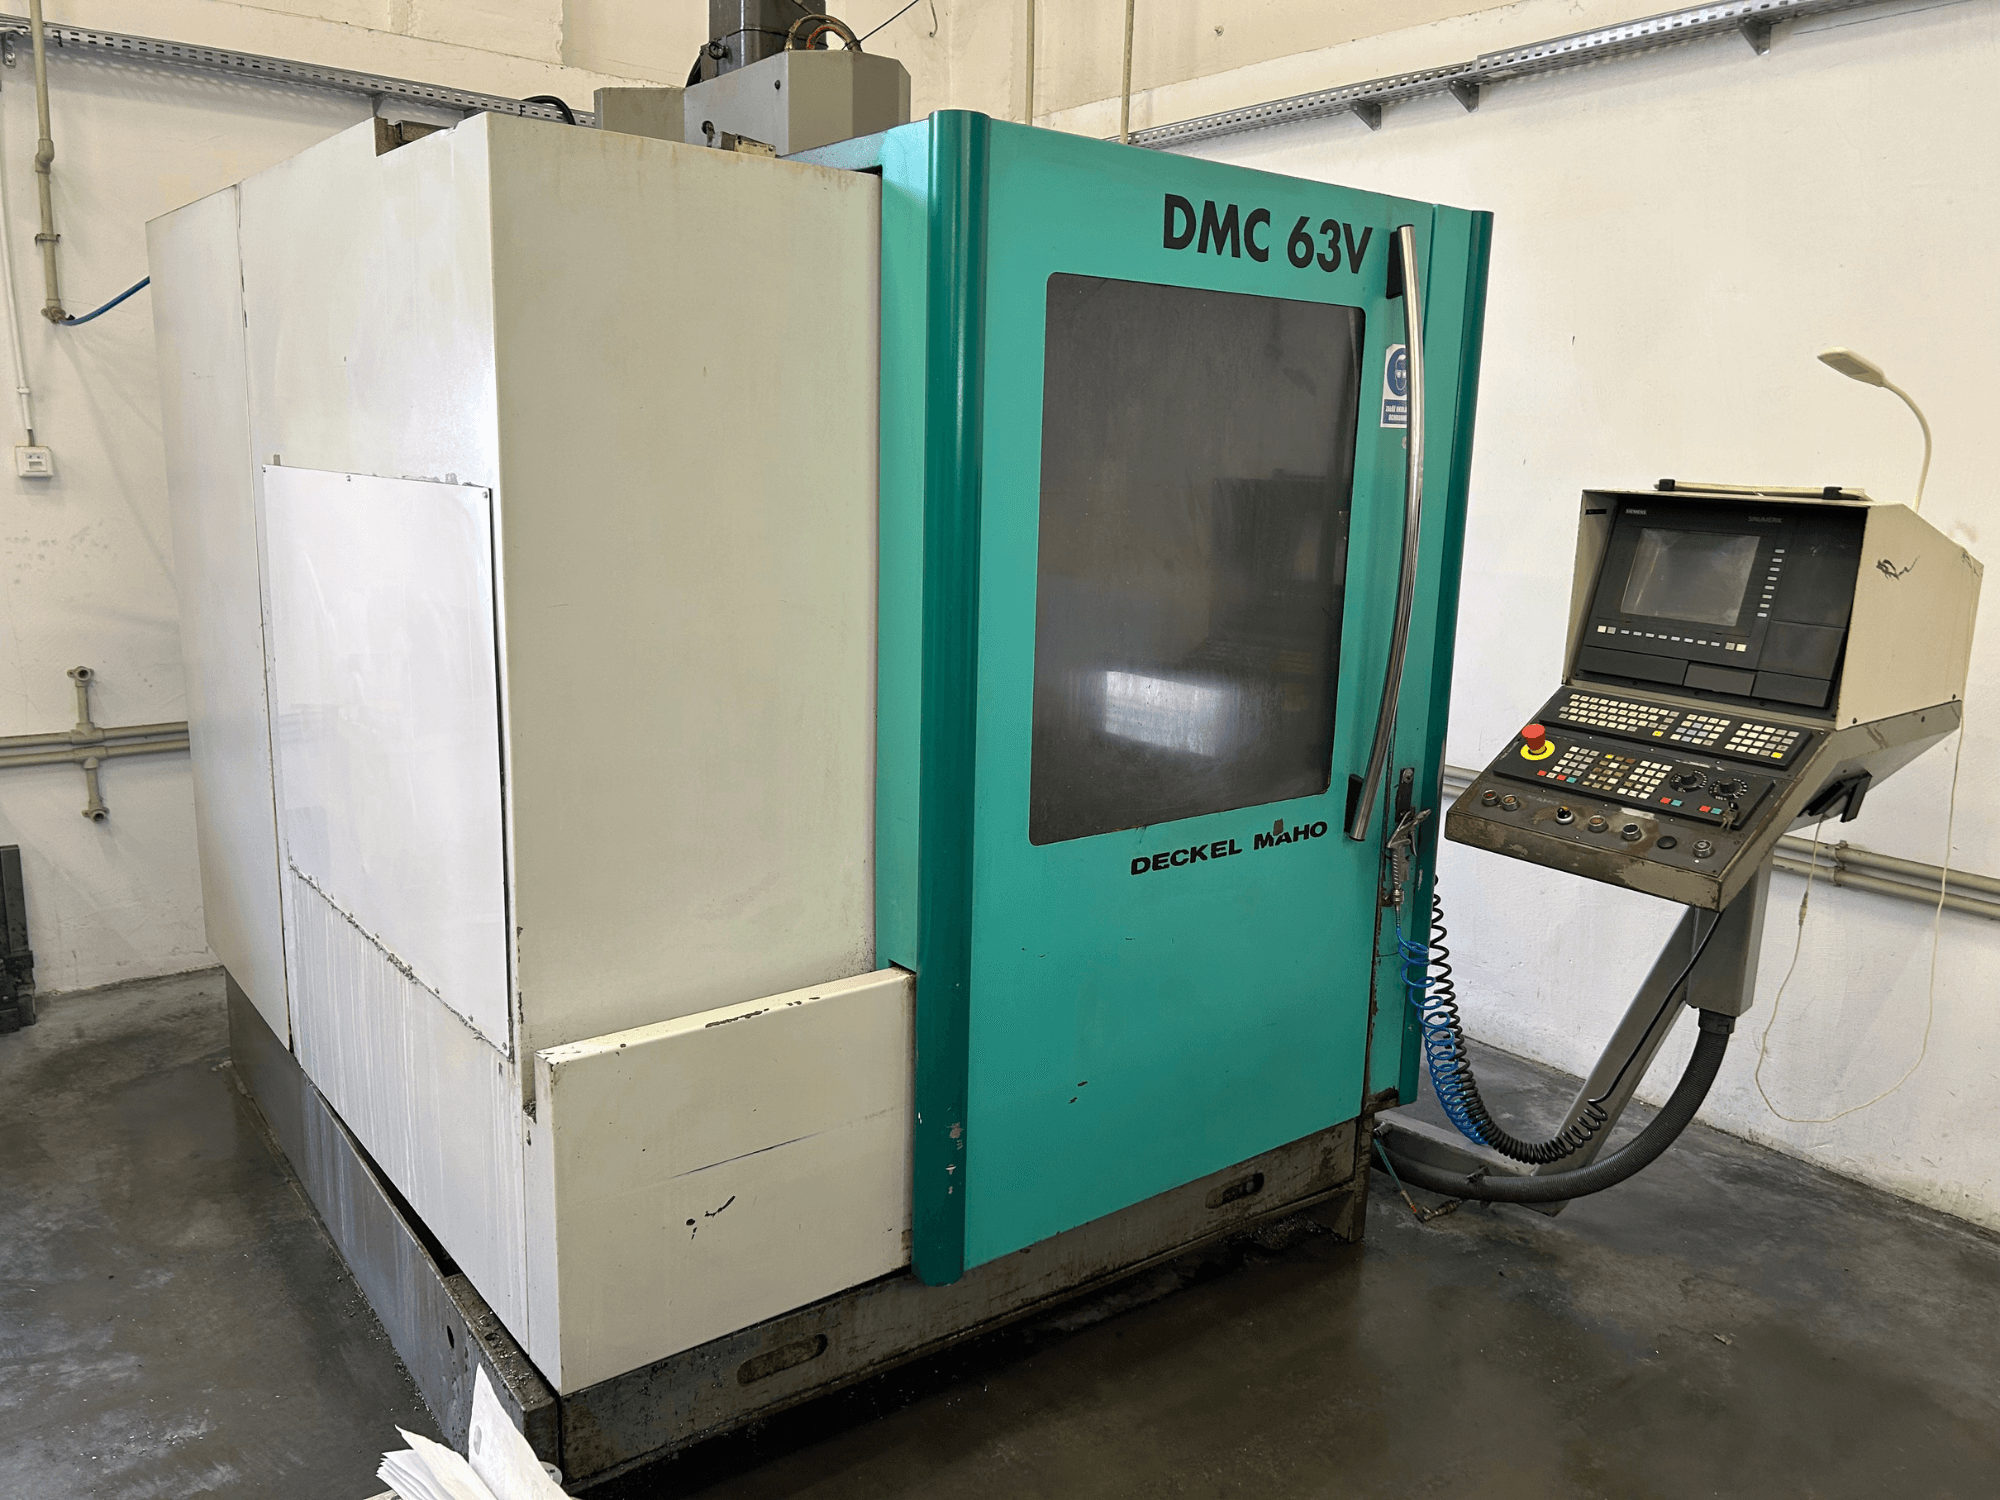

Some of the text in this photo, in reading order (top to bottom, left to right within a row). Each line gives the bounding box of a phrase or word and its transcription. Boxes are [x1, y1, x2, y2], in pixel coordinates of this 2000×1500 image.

[1163, 193, 1374, 275] DMC 63V
[1130, 821, 1328, 876] DECKEL MAHO
